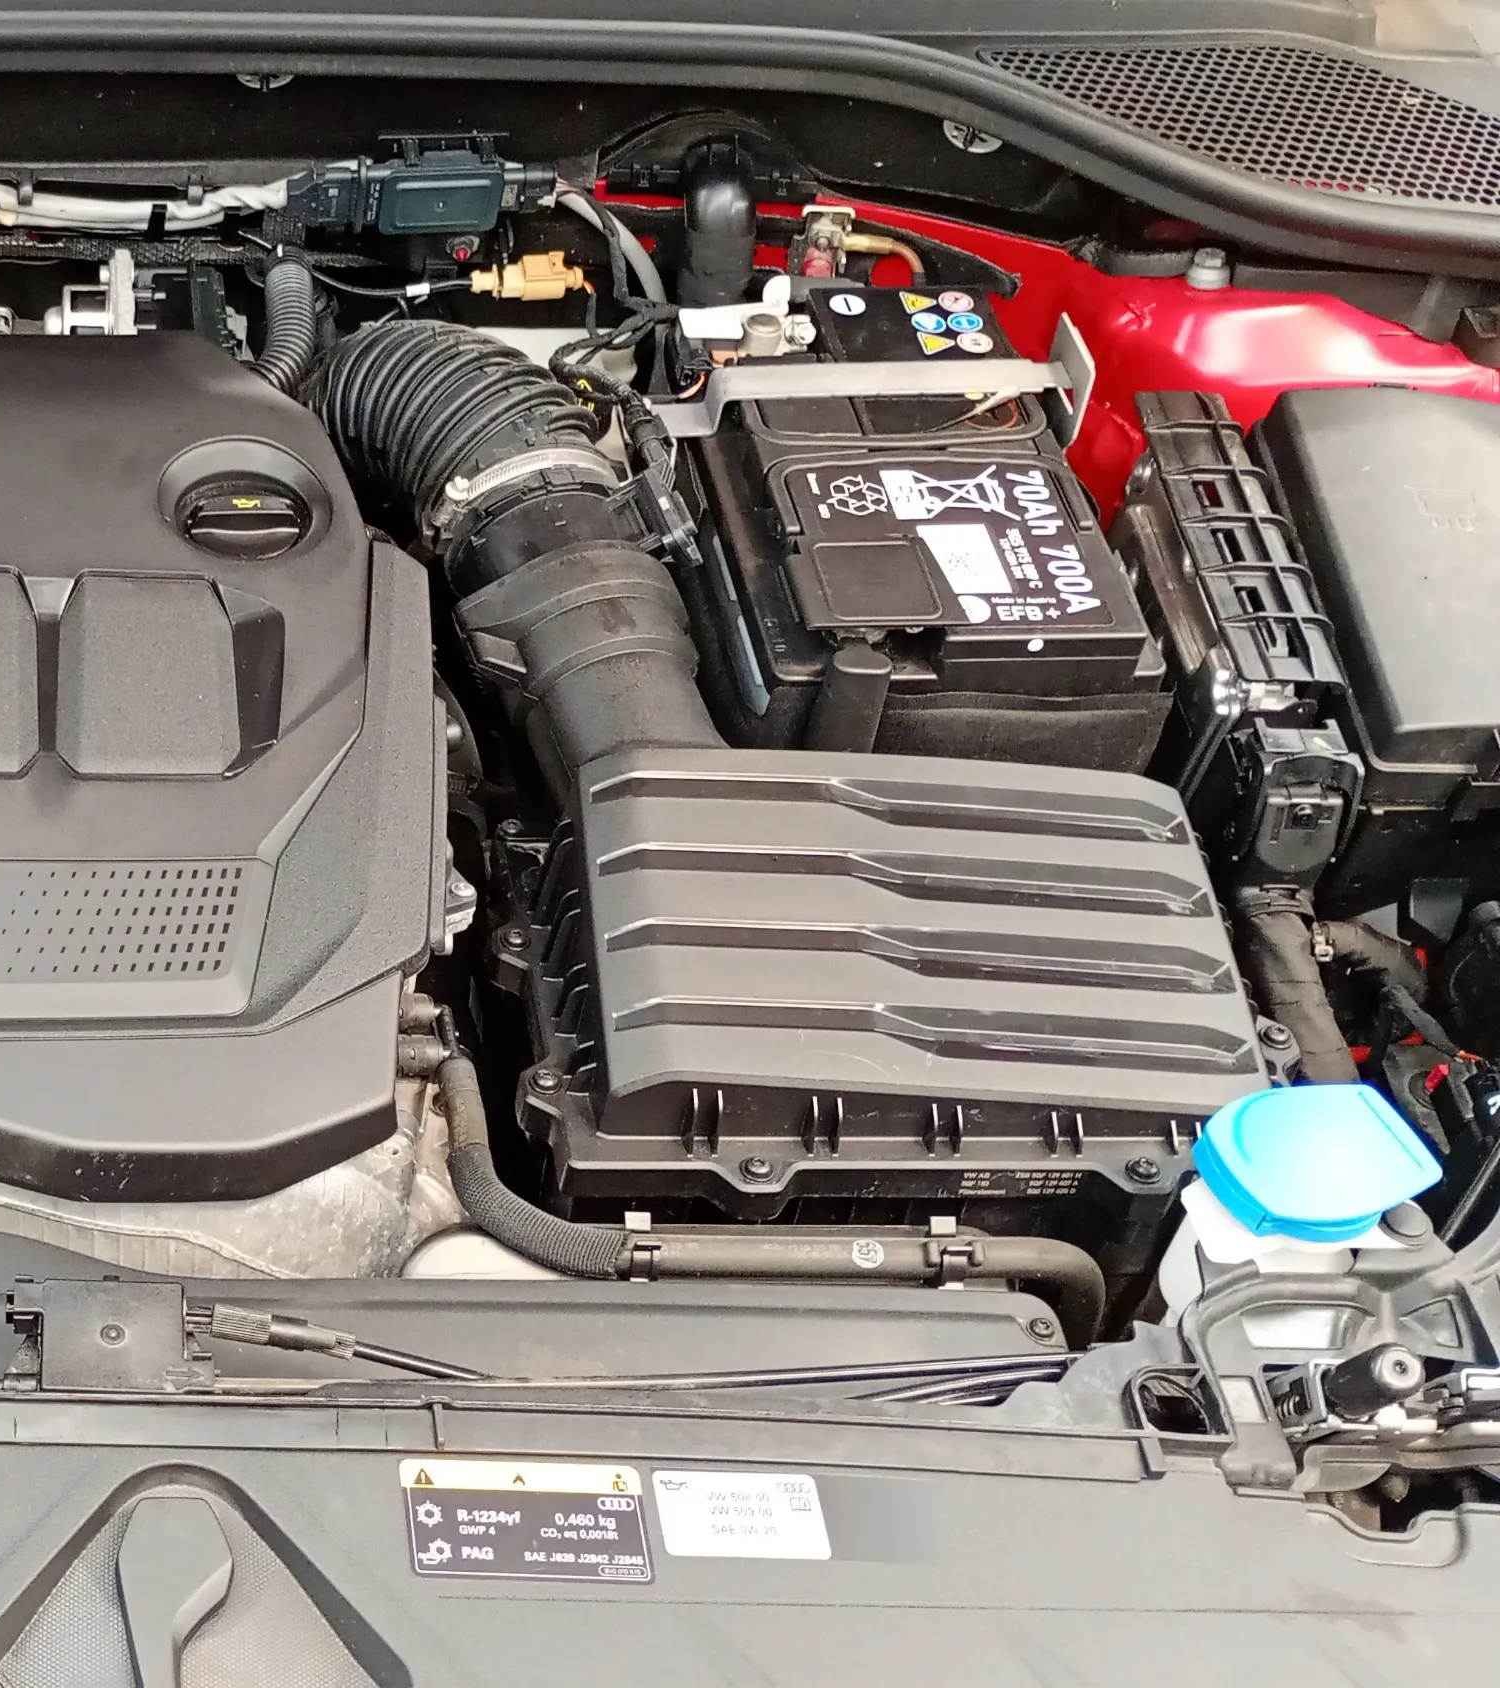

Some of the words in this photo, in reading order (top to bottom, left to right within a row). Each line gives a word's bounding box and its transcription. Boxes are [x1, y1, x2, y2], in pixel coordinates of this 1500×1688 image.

[1005, 470, 1064, 535] 70Ah
[1039, 544, 1101, 614] 700A
[996, 606, 1043, 621] EFB
[456, 1509, 521, 1526] R-1234yf
[554, 1512, 595, 1528] 0,460
[598, 1514, 617, 1530] kg
[459, 1525, 487, 1535] GWP
[488, 1526, 496, 1536] 4
[461, 1546, 494, 1560] PAG
[524, 1550, 548, 1562] SAE
